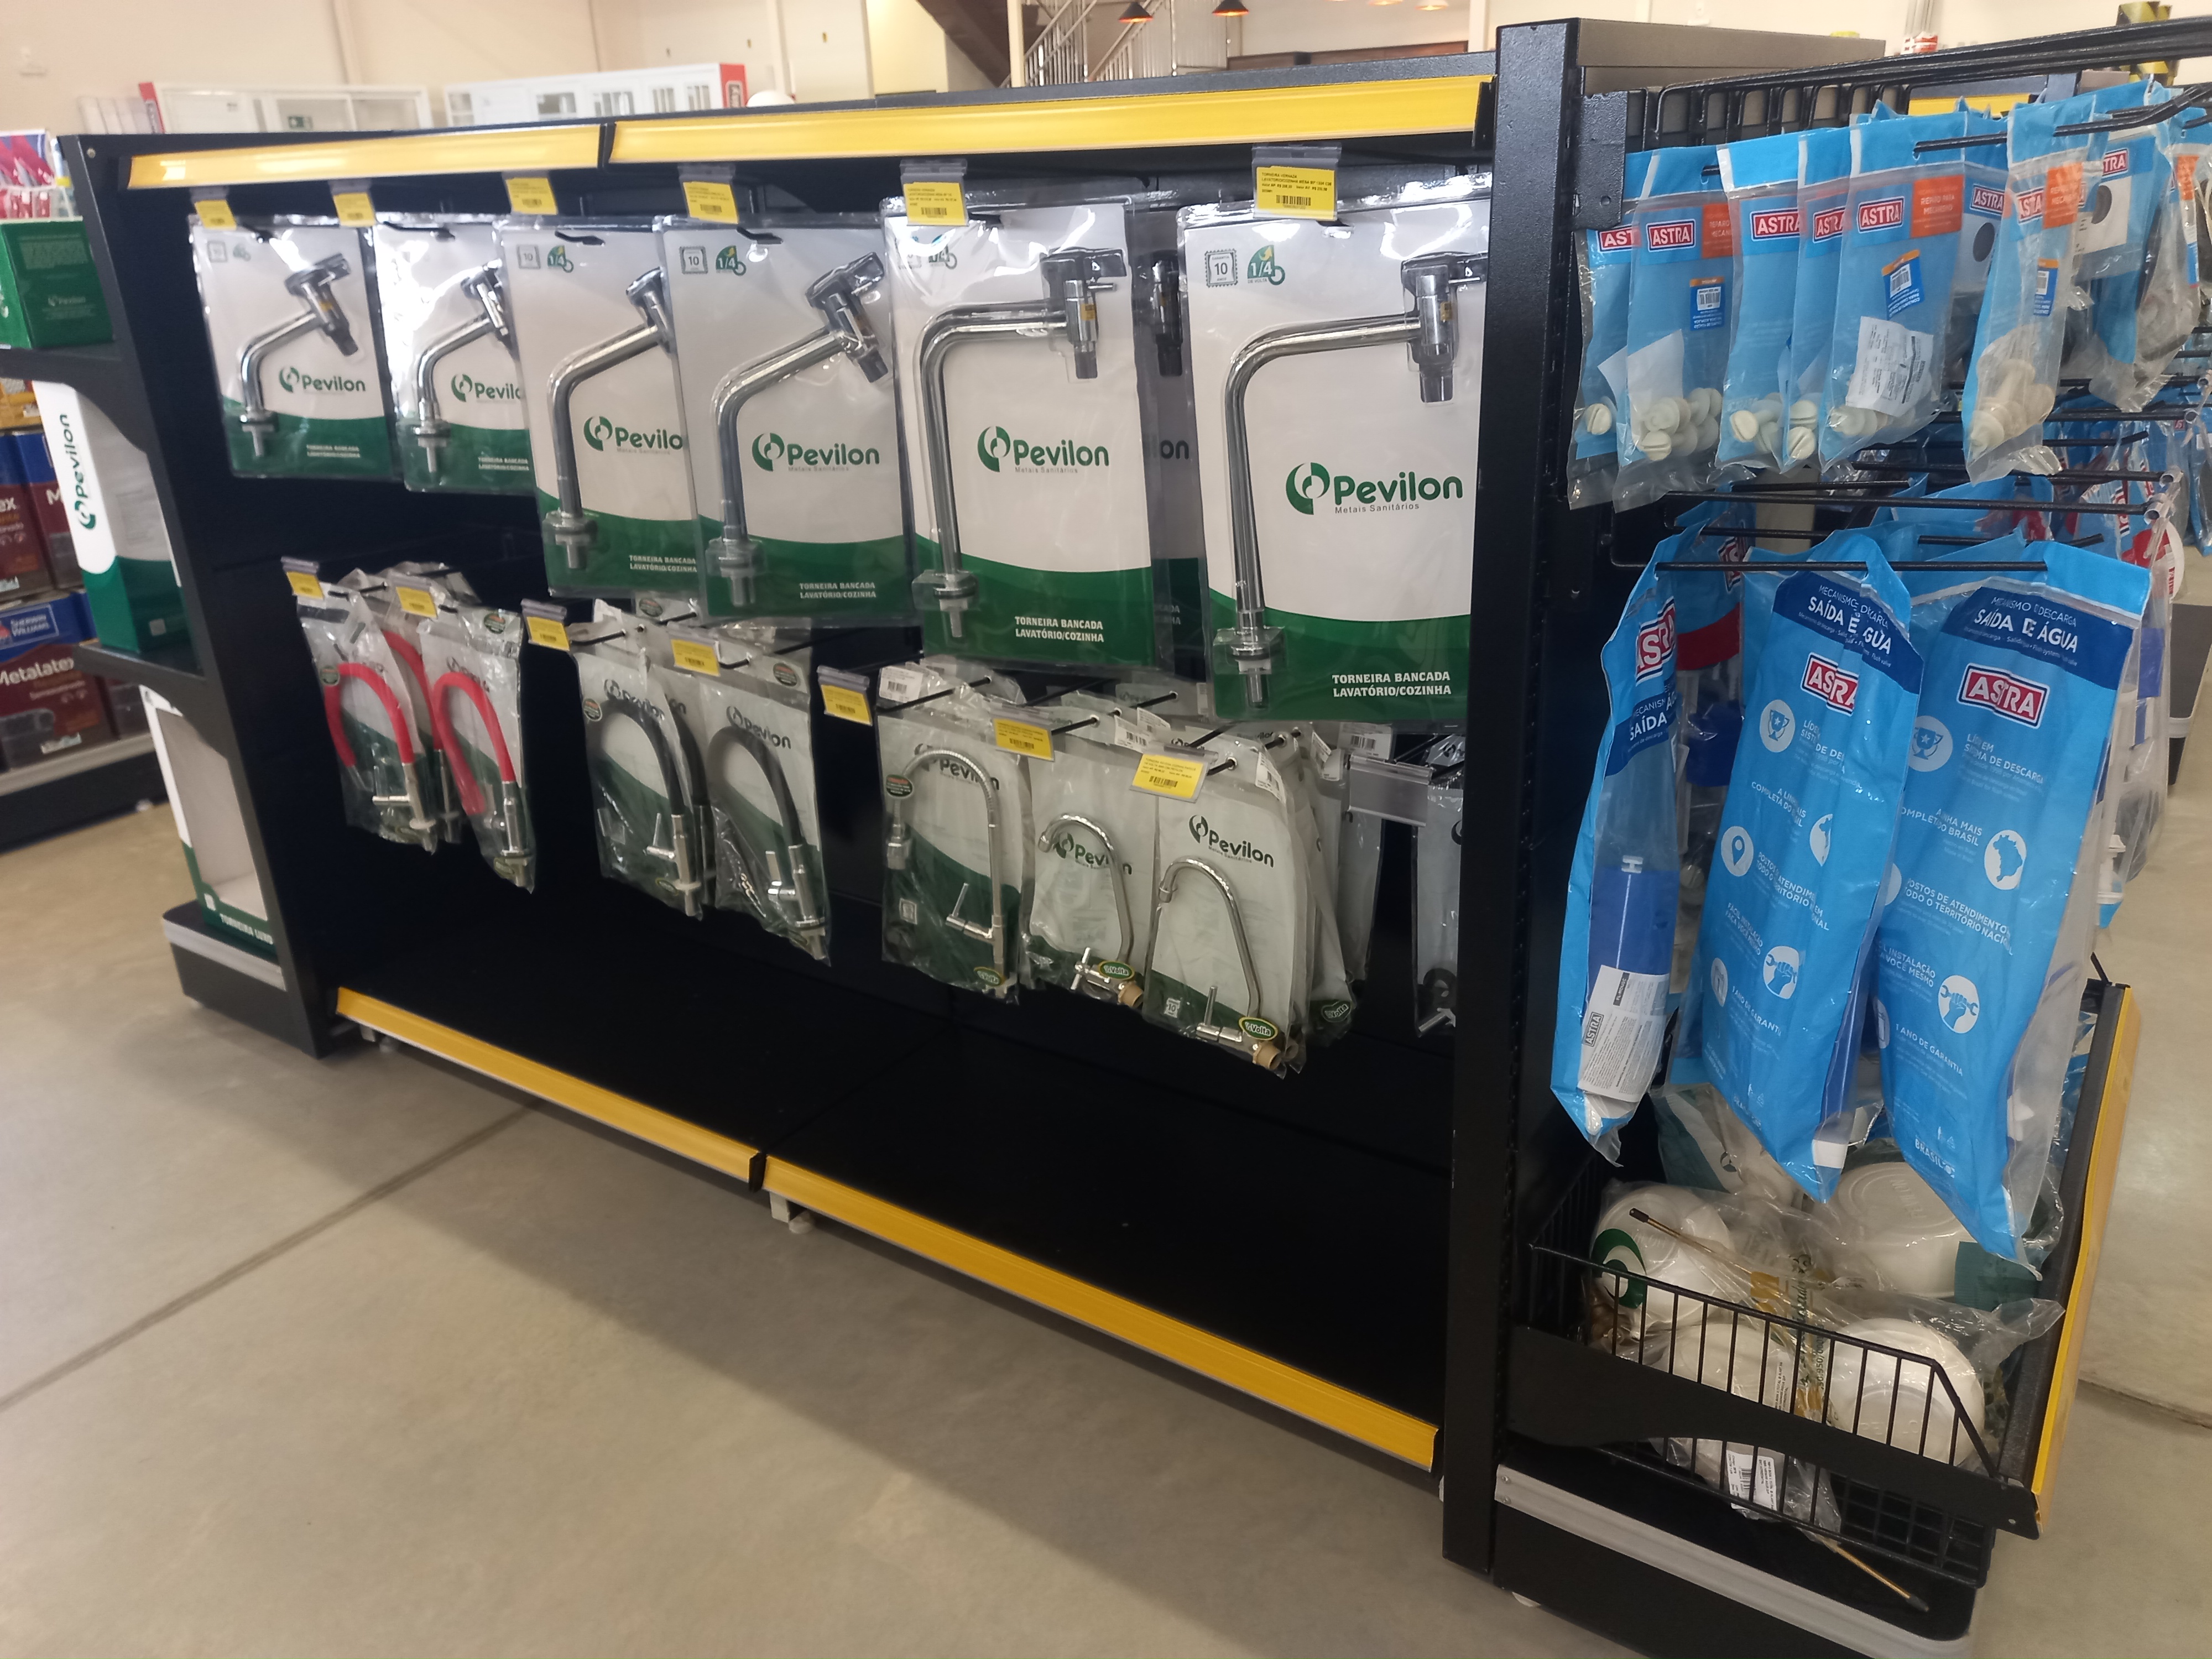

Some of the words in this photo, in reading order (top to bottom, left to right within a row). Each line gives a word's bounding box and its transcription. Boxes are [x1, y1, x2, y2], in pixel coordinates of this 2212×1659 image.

[1974, 191, 2004, 211] ASTRA
[1861, 204, 1900, 227] ASTRA
[1652, 226, 1691, 246] ASTRA
[688, 255, 700, 266] 10
[1214, 262, 1228, 275] 10
[1250, 261, 1272, 277] 1/4
[301, 373, 366, 392] Pevilon
[614, 426, 684, 450] Pevilo
[787, 443, 880, 466] Pevilon
[1013, 439, 1109, 466] Pevilon
[1333, 471, 1463, 506] Pevilon
[1335, 506, 1366, 515] Metais
[1369, 503, 1420, 513] Sanitários
[629, 555, 663, 563] TORNEIRA
[1808, 596, 1844, 626] SAÍDA
[1015, 615, 1059, 628] TORNEIRA
[1061, 619, 1104, 630] BANCADA
[1974, 608, 2014, 632] SAÍDA
[2036, 620, 2078, 653] ÁGUA
[1015, 628, 1105, 643] LAVATÓRIO/COZINHA
[1332, 673, 1391, 684] TORNEIRA
[1395, 671, 1451, 682] BANCADA
[1333, 684, 1452, 698] LAVATÓRIO/COZINHA
[1968, 676, 2034, 718] ASTRA
[1989, 755, 2002, 767] DE
[1948, 827, 1979, 847] BRASIL
[1960, 820, 1983, 836] MAIS
[1208, 829, 1274, 868] Pevilon
[1937, 892, 1949, 904] DE
[1926, 898, 1933, 906] O
[1935, 901, 1982, 932] TERRITÓRIO
[1886, 956, 1907, 972] VOCÊ
[1908, 967, 1934, 988] MESMO
[1888, 947, 1936, 979] INSTALAÇÃO
[1168, 1003, 1177, 1013] 10
[1250, 1025, 1271, 1037] Volta
[1586, 1014, 1602, 1045] ASTRA
[1900, 1026, 1918, 1041] ANO
[1918, 1037, 1929, 1050] DE
[1929, 1045, 1964, 1077] GARANTIA
[1914, 1138, 1944, 1169] BRASIL
